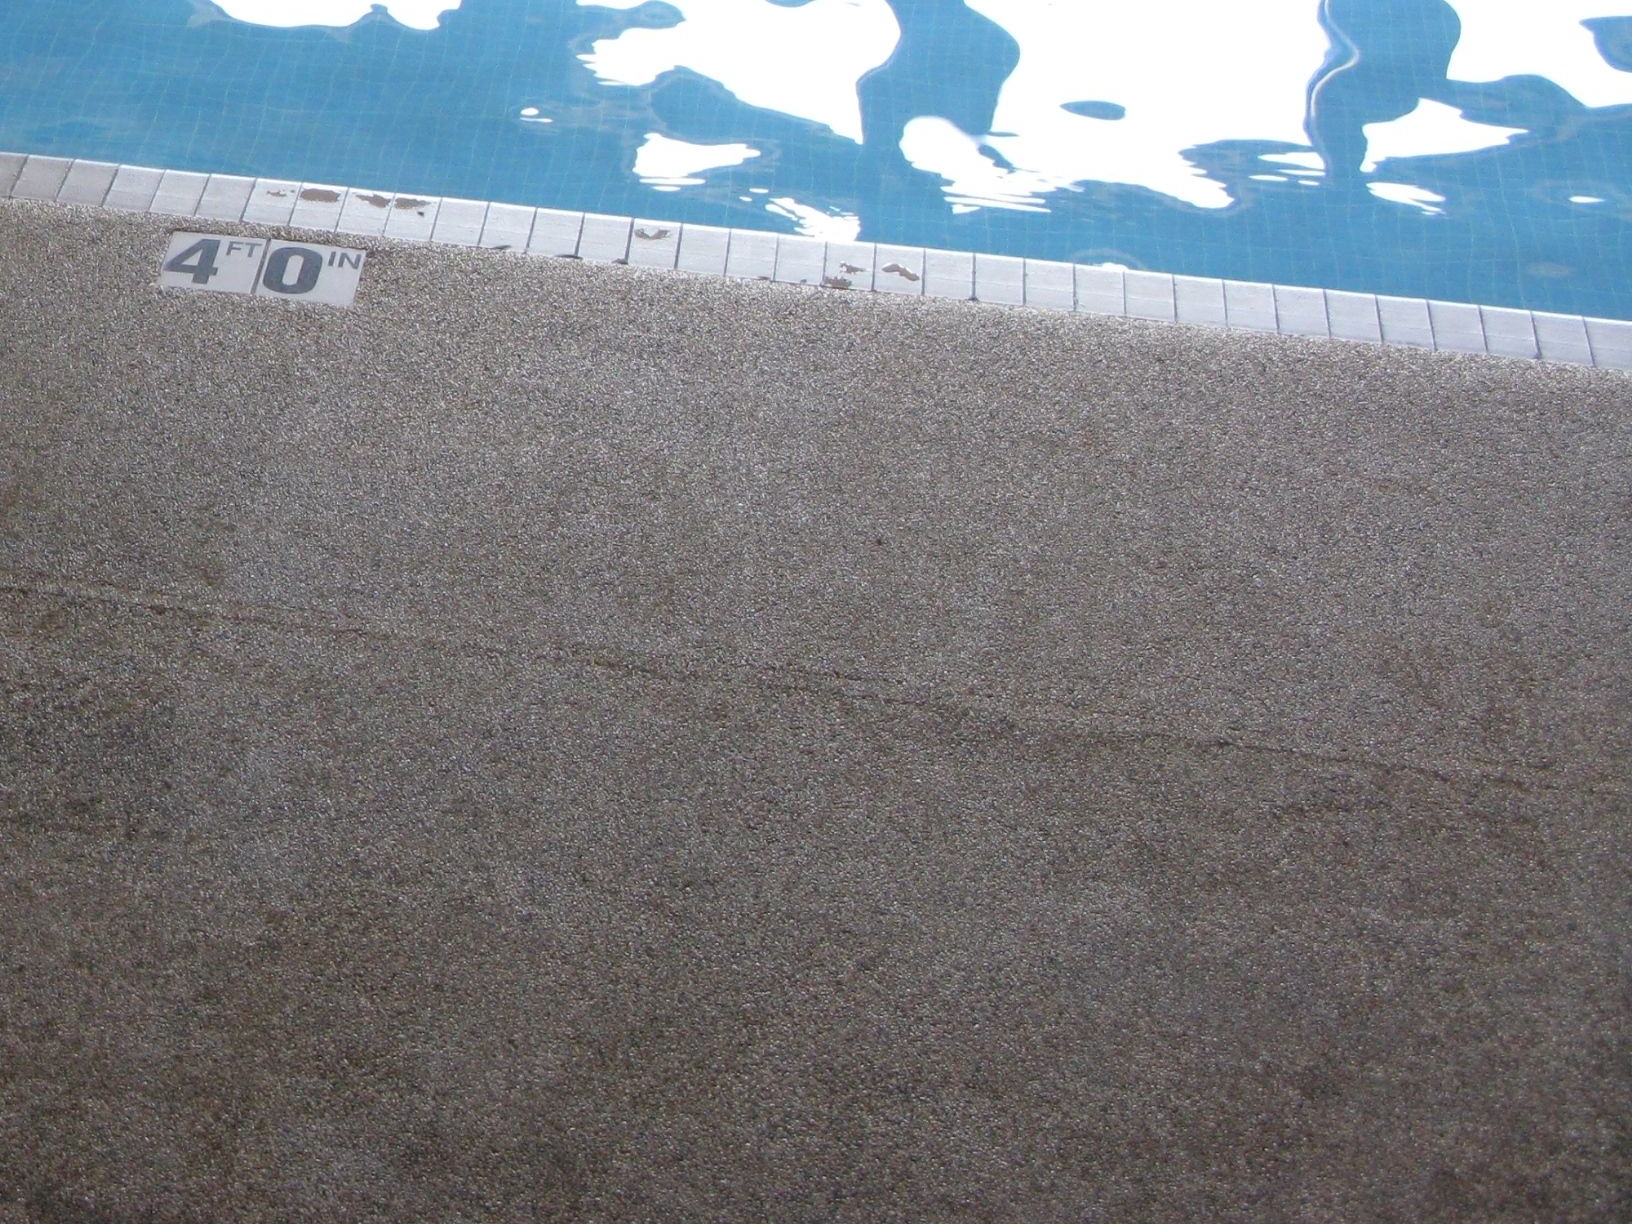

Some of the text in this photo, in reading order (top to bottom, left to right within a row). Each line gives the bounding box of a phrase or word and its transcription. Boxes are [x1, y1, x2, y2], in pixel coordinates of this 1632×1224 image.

[163, 239, 362, 294] 4 FT 0 IN
